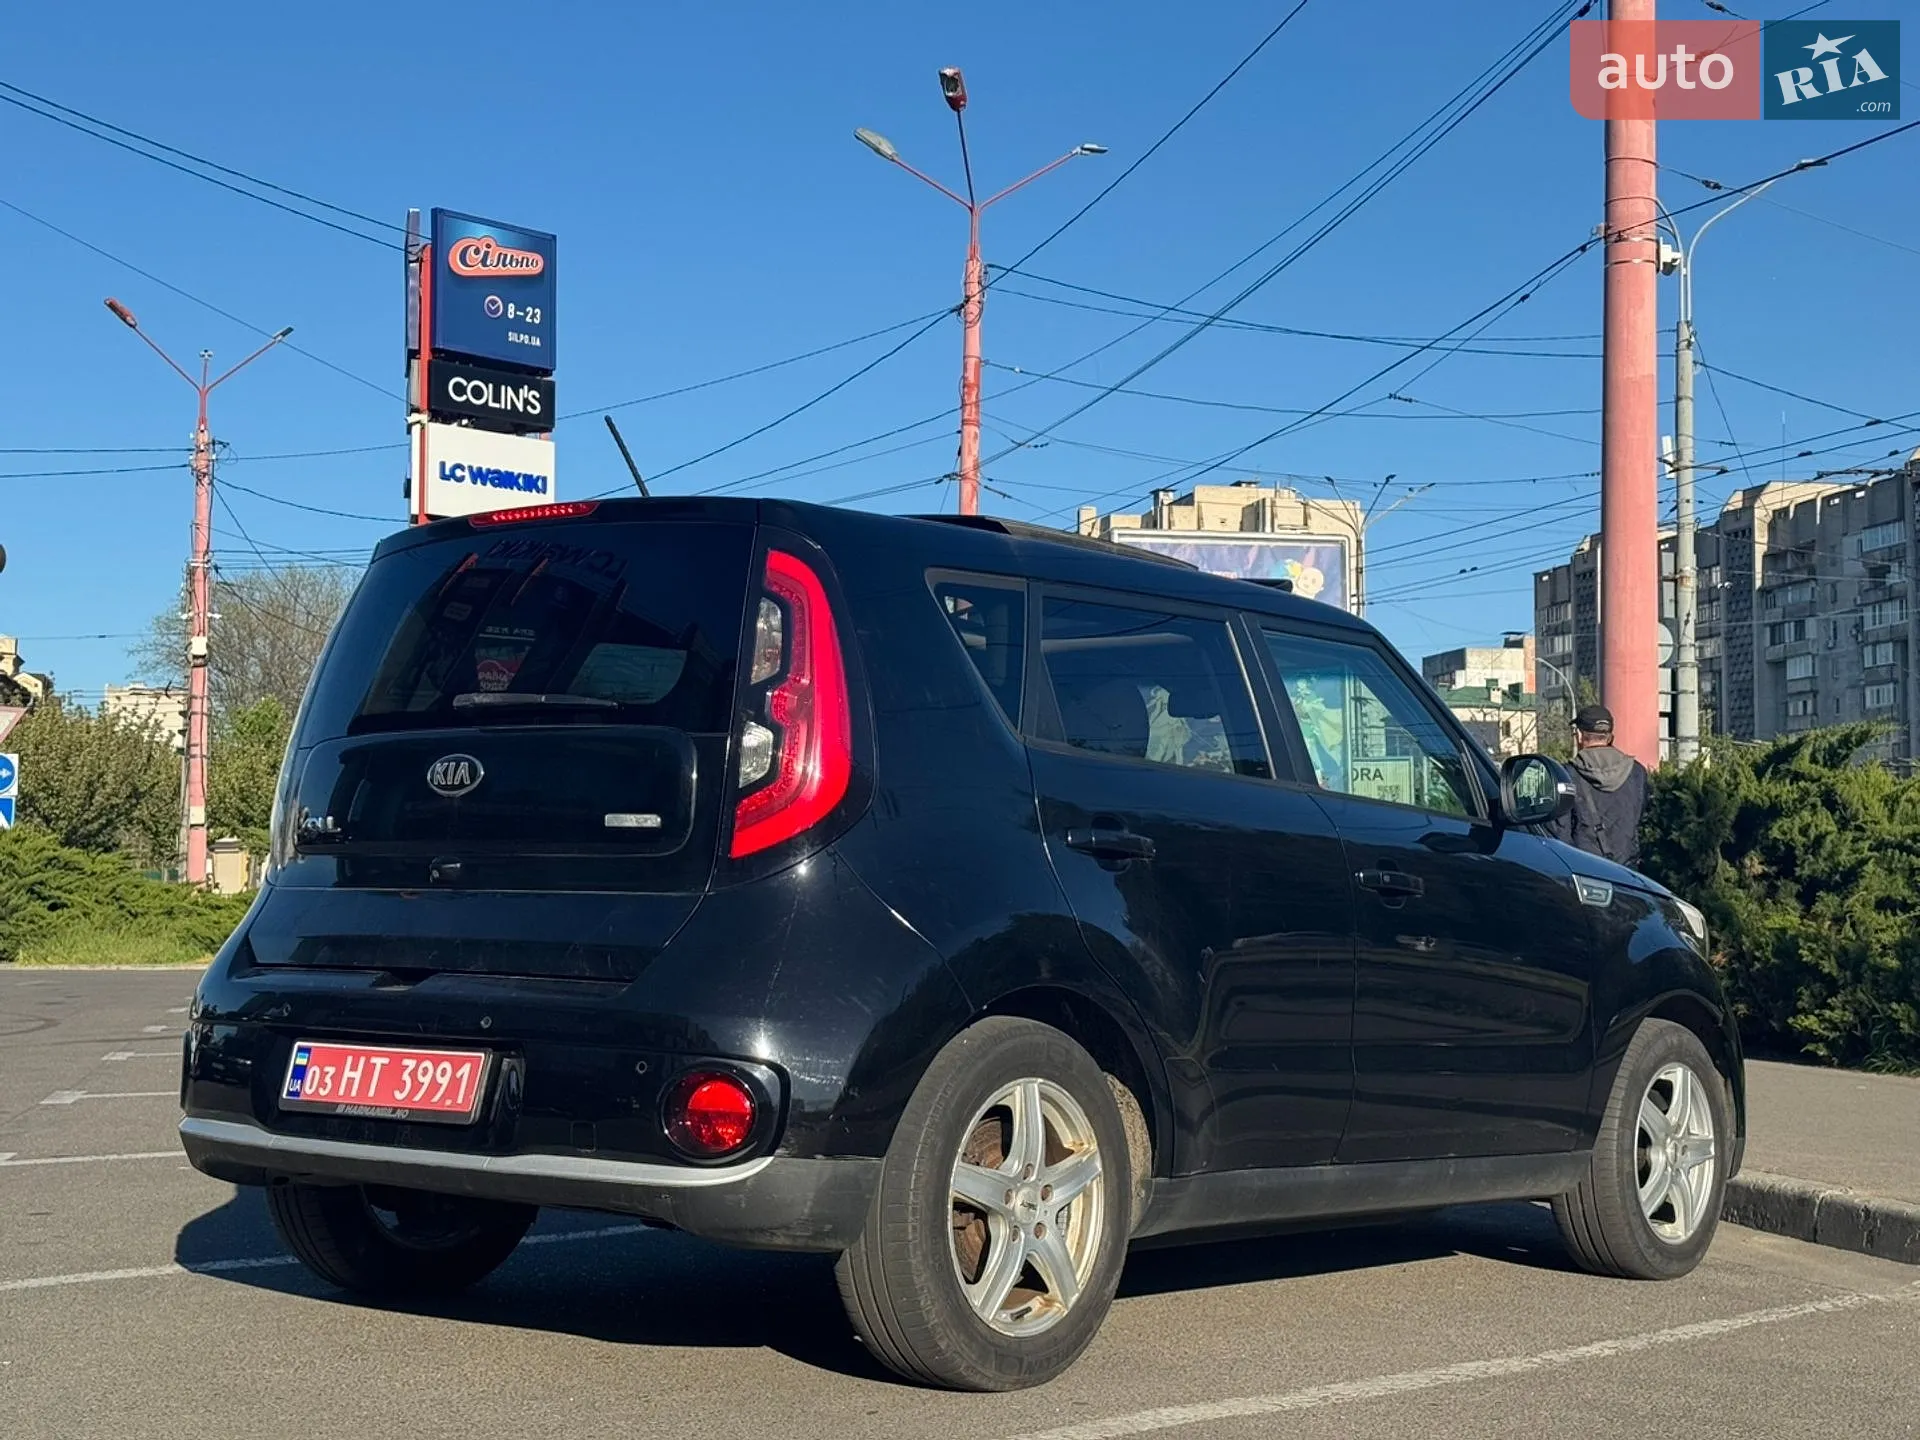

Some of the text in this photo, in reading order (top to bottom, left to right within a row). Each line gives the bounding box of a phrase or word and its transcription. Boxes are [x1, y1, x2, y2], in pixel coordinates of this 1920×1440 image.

[458, 242, 539, 269] Сільпо
[507, 302, 541, 324] 8-23
[508, 331, 541, 347] SILPO.UA
[448, 376, 541, 415] COLIN'S
[439, 461, 466, 483] LC
[433, 761, 471, 785] KIA
[289, 1079, 302, 1092] UA
[304, 1065, 336, 1096] 03
[338, 1055, 390, 1098] HT
